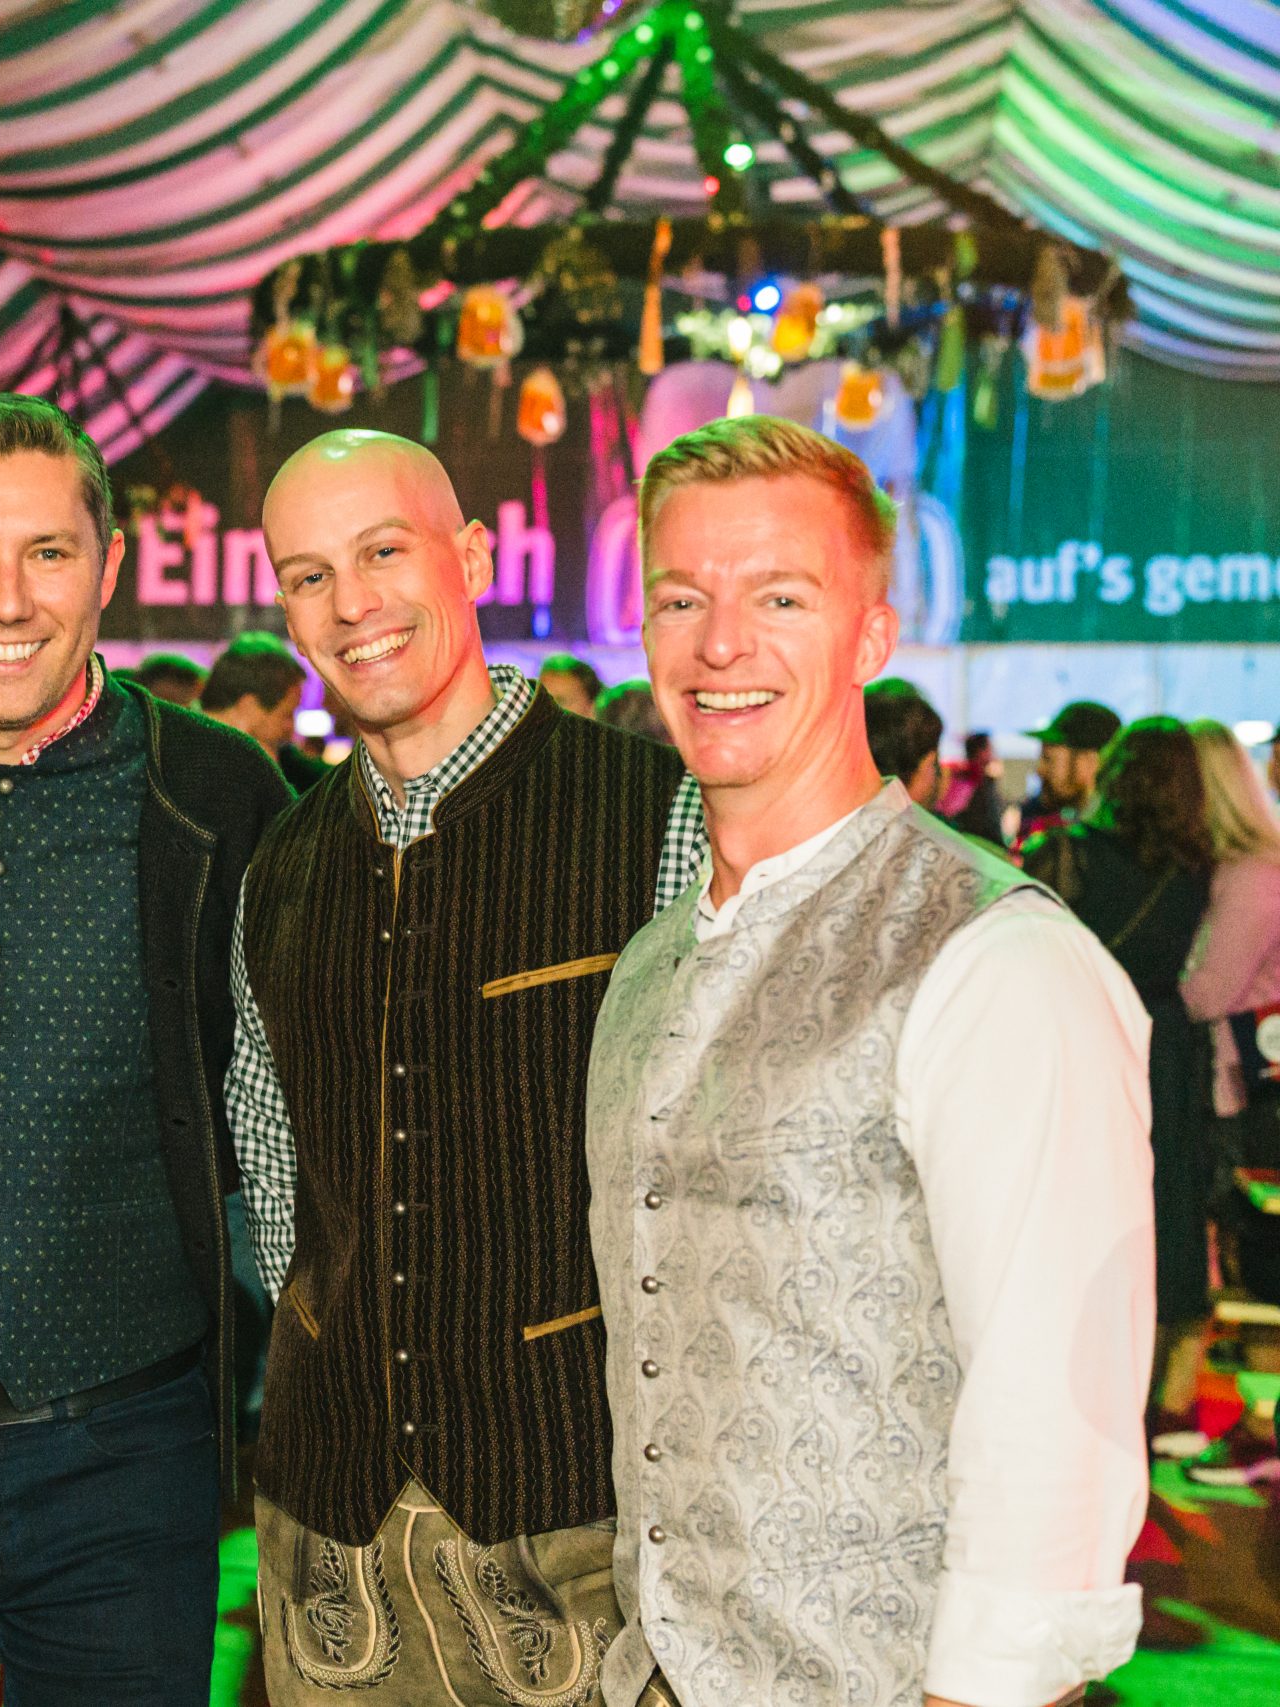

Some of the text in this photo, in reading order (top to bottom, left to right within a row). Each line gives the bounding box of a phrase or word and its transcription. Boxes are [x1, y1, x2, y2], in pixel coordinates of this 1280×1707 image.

[137, 500, 556, 606] Einh
[985, 539, 1280, 616] auf's gem
